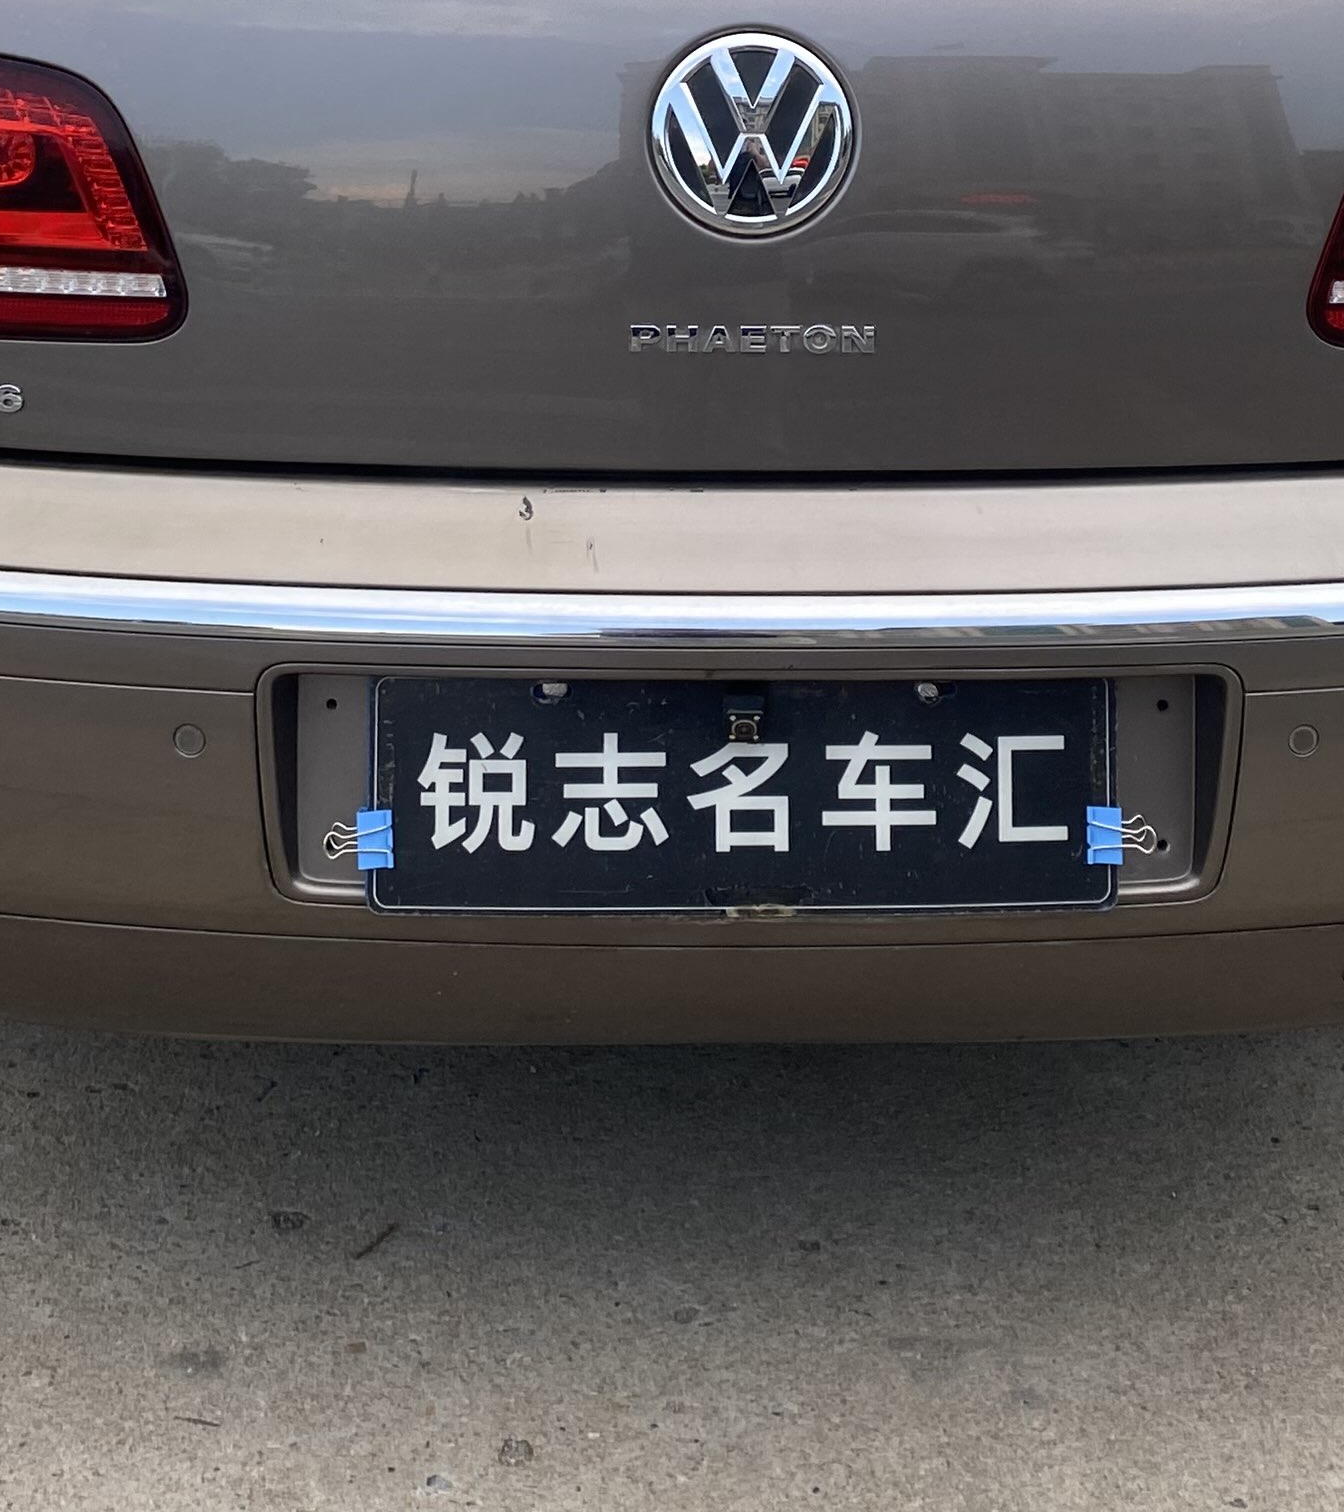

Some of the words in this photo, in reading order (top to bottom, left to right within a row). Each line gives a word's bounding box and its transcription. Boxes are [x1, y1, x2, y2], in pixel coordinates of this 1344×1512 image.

[628, 323, 877, 354] PHAETON
[416, 730, 1069, 855] 锐志名车汇
